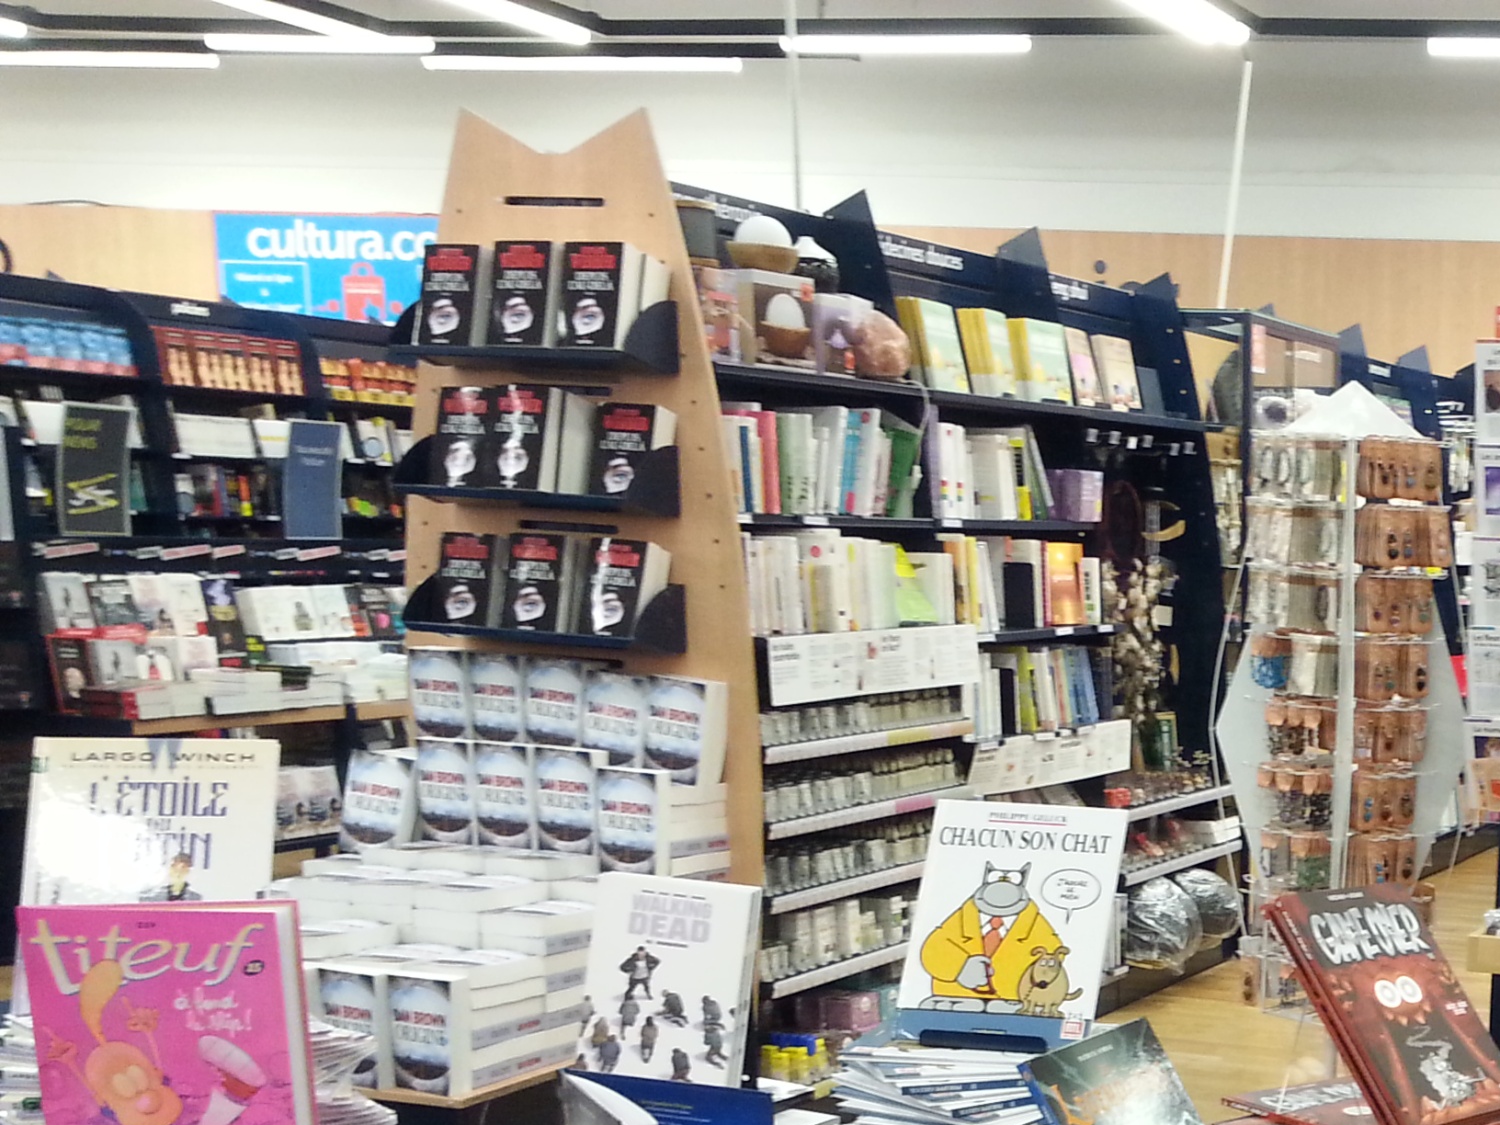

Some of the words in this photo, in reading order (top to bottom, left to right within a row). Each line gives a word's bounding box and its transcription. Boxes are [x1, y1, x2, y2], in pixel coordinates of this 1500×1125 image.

[926, 245, 963, 271] douces
[1048, 275, 1069, 301] eng
[71, 751, 155, 763] LARGO
[174, 751, 256, 764] WINCH
[939, 826, 1015, 849] CHACUN
[1018, 830, 1057, 851] SON
[1061, 833, 1112, 854] CHAT
[632, 893, 713, 920] WALKING
[628, 911, 711, 943] DEAD
[1310, 905, 1385, 965] GAME
[1363, 902, 1431, 956] OVER
[29, 919, 265, 996] titeuf
